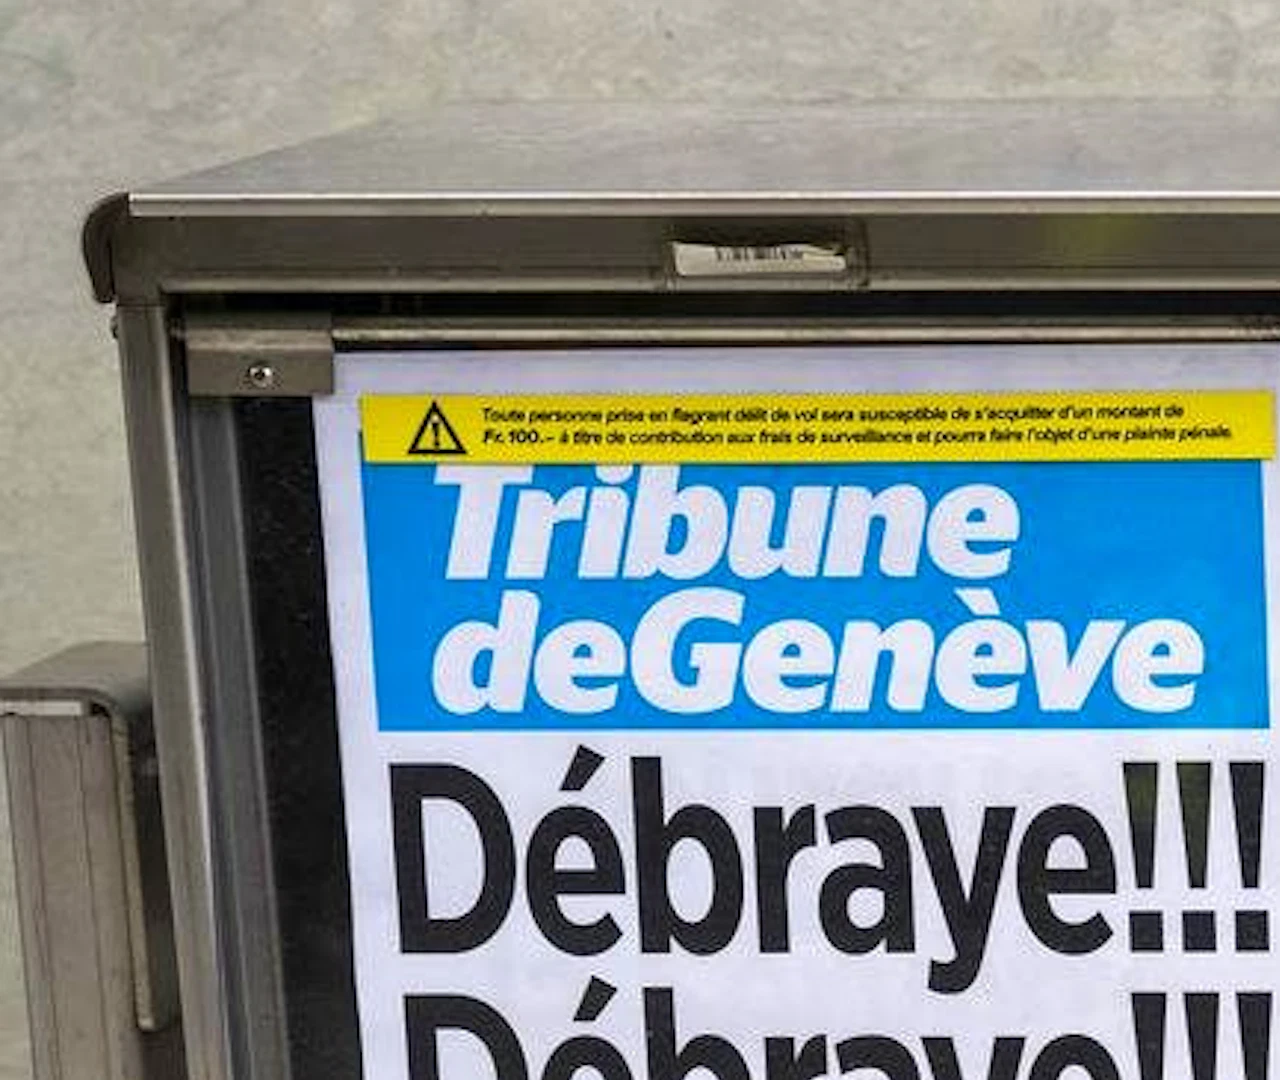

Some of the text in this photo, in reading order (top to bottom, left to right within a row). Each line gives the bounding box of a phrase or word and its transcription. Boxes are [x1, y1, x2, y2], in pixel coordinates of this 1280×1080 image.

[482, 404, 1184, 425] Toute personne prise en flagrant délit de vol sera susceptible de s'acquitter d'un montant de
[484, 429, 505, 444] Fr.
[559, 430, 569, 443] à
[573, 431, 601, 443] titre
[606, 431, 626, 443] de
[630, 430, 724, 443] contribution
[728, 433, 755, 443] aux
[760, 430, 791, 443] frais
[799, 430, 815, 443] de
[822, 430, 913, 443] surveillance
[917, 431, 931, 443] et
[933, 432, 986, 446] pourra
[990, 428, 1022, 441] faire
[1027, 428, 1074, 444] l'objet
[1078, 428, 1120, 440] d'une
[1126, 427, 1176, 442] plainte
[1179, 426, 1232, 442] pénale.
[432, 464, 1018, 577] Tribune
[432, 587, 1203, 712] deGenève
[389, 745, 1269, 994] Débraye!!!
